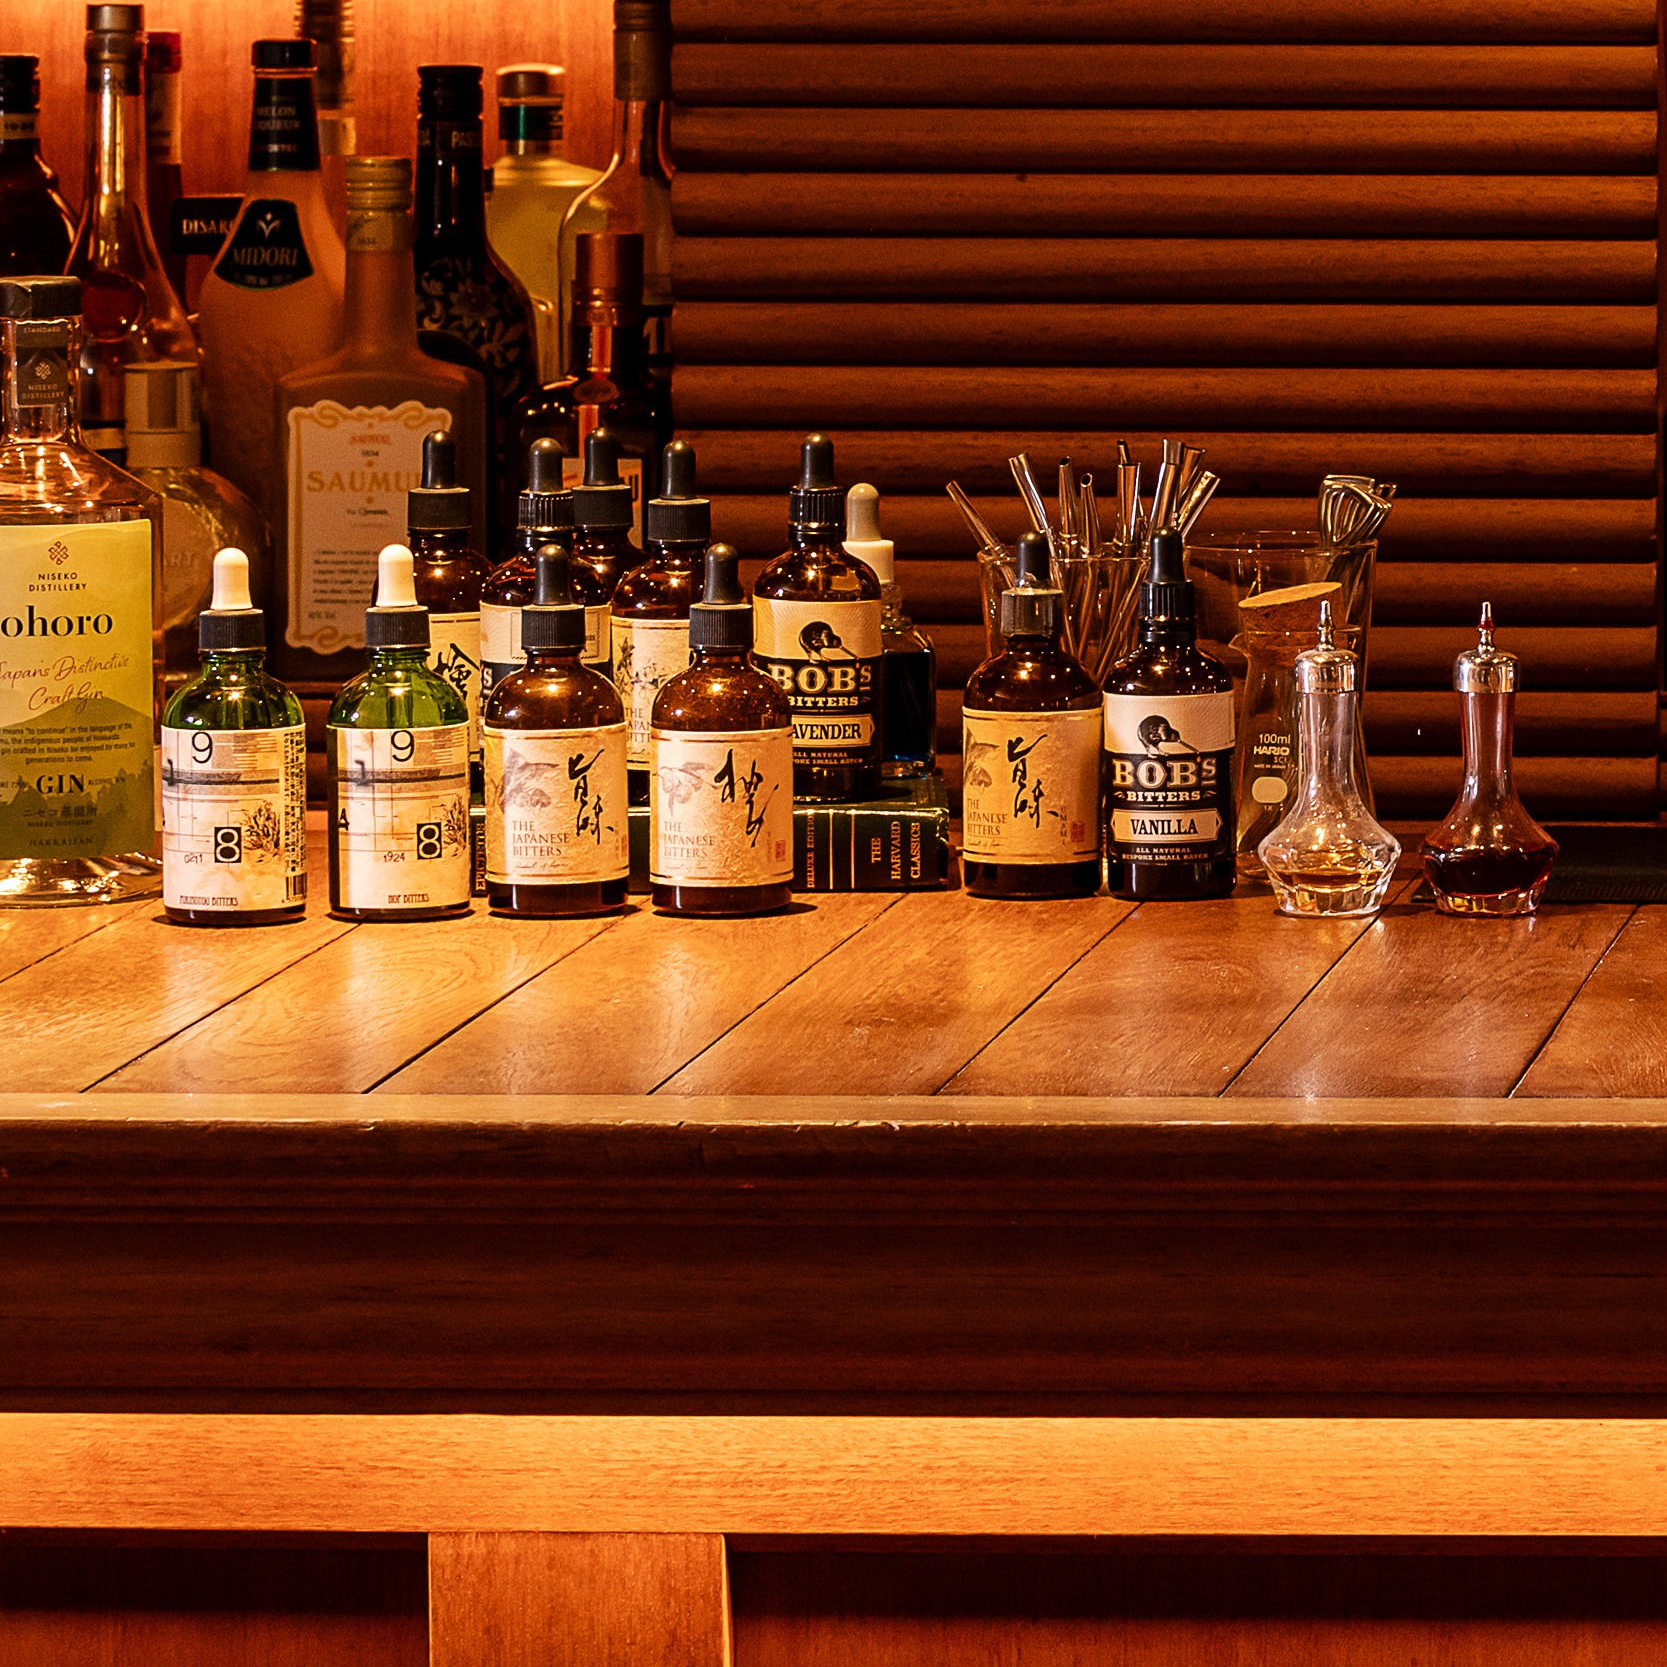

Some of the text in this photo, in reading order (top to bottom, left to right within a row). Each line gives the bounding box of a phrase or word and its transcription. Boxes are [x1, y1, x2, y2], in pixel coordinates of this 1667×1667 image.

[230, 245, 299, 267] MIDORI
[38, 572, 78, 581] NISEKO
[28, 583, 88, 592] DISTILLERY
[0, 604, 114, 638] ohoro
[52, 652, 130, 682] Distinctive
[767, 662, 872, 694] BOB'S
[28, 681, 104, 715] Craft Gin
[787, 695, 859, 708] BITTERS
[624, 707, 644, 719] THE
[792, 722, 862, 740] AVENDER
[390, 729, 415, 762] 9
[1258, 733, 1292, 745] 100ml
[191, 730, 214, 765] 9
[1253, 745, 1291, 756] HARIO
[1273, 756, 1288, 764] SCI
[1111, 756, 1217, 789] BOB'S
[36, 773, 85, 795] GIN
[1126, 790, 1201, 802] BITTERS
[967, 797, 980, 810] THE
[1263, 804, 1274, 812] 1X
[967, 811, 1008, 824] JAPANESE
[511, 820, 536, 832] THE
[663, 820, 683, 833] THE
[967, 823, 1001, 836] BITTERS
[1130, 817, 1199, 835] VANILLA
[28, 837, 93, 847] HAKKAISAN
[216, 827, 240, 863] 8
[417, 823, 441, 860] 8
[512, 833, 570, 845] JAPANESE
[663, 835, 715, 847] JAPANESE
[512, 845, 563, 857] BITTERS
[663, 847, 708, 859] BITTERS
[870, 837, 882, 865] THE
[890, 820, 902, 880] HARVARD
[909, 821, 921, 879] CLASSICS
[183, 852, 204, 865] 0211
[383, 851, 406, 864] 1924
[1121, 853, 1153, 861] BESPOKE
[1154, 853, 1181, 861] SMALL
[806, 851, 815, 889] DELUXE
[211, 896, 239, 907] BITTERS
[403, 892, 430, 904] BITTERS
